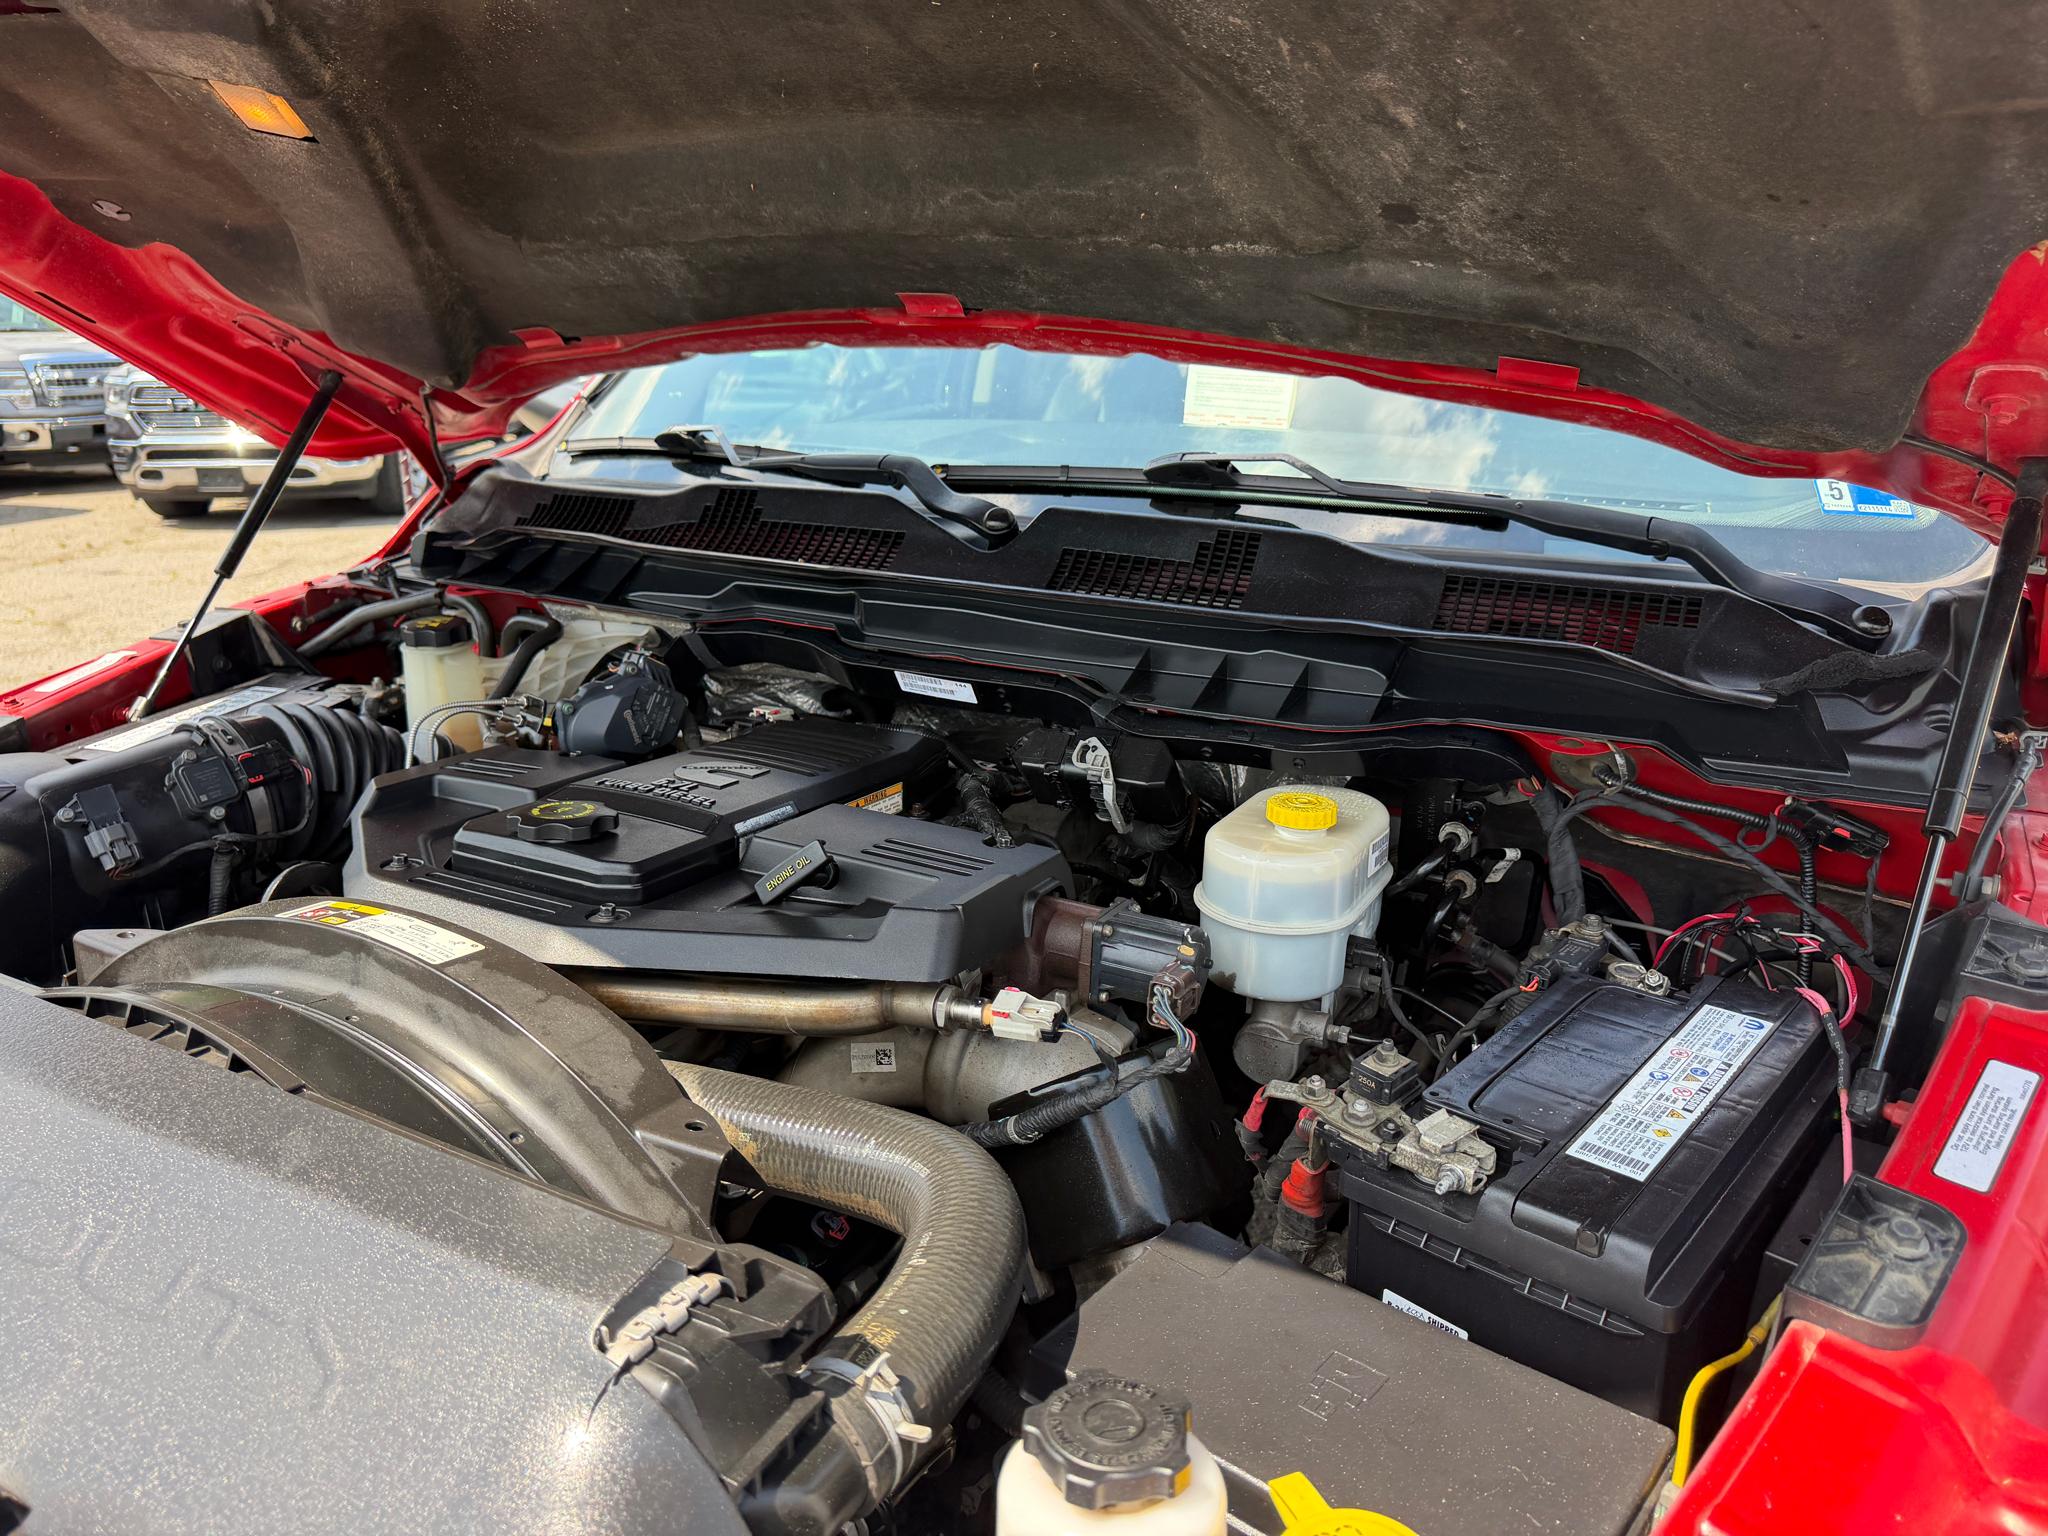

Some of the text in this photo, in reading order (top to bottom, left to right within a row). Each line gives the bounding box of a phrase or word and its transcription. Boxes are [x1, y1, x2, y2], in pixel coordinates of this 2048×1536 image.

[1827, 480, 1844, 501] 5
[595, 777, 717, 809] TURBO DIESEL
[765, 856, 812, 892] ENGINE OIL
[1358, 1074, 1377, 1090] 250A
